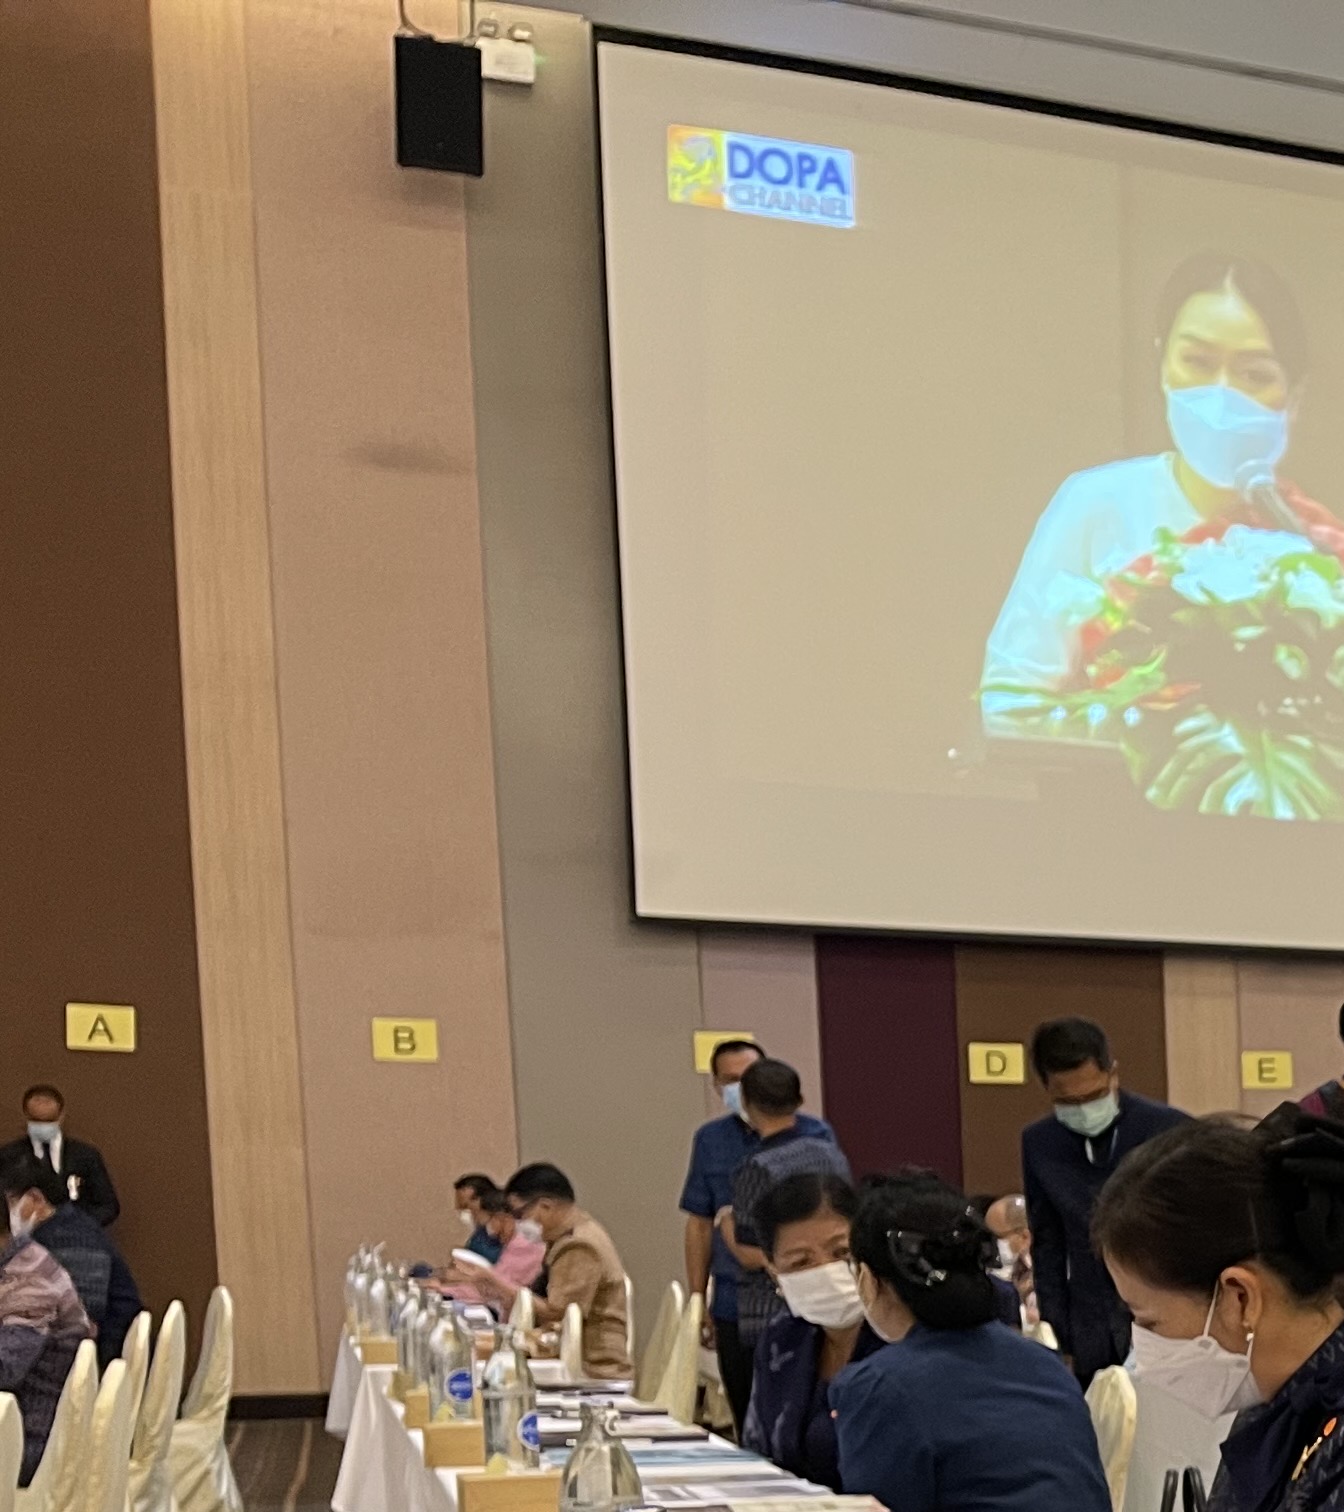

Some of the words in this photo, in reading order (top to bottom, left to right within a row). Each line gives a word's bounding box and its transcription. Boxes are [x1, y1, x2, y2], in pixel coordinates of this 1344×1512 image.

[728, 140, 846, 195] DOPA
[729, 183, 852, 220] CHANNEL
[87, 1012, 115, 1044] A
[392, 1025, 416, 1056] B
[984, 1050, 1007, 1077] D
[1257, 1057, 1278, 1084] E
